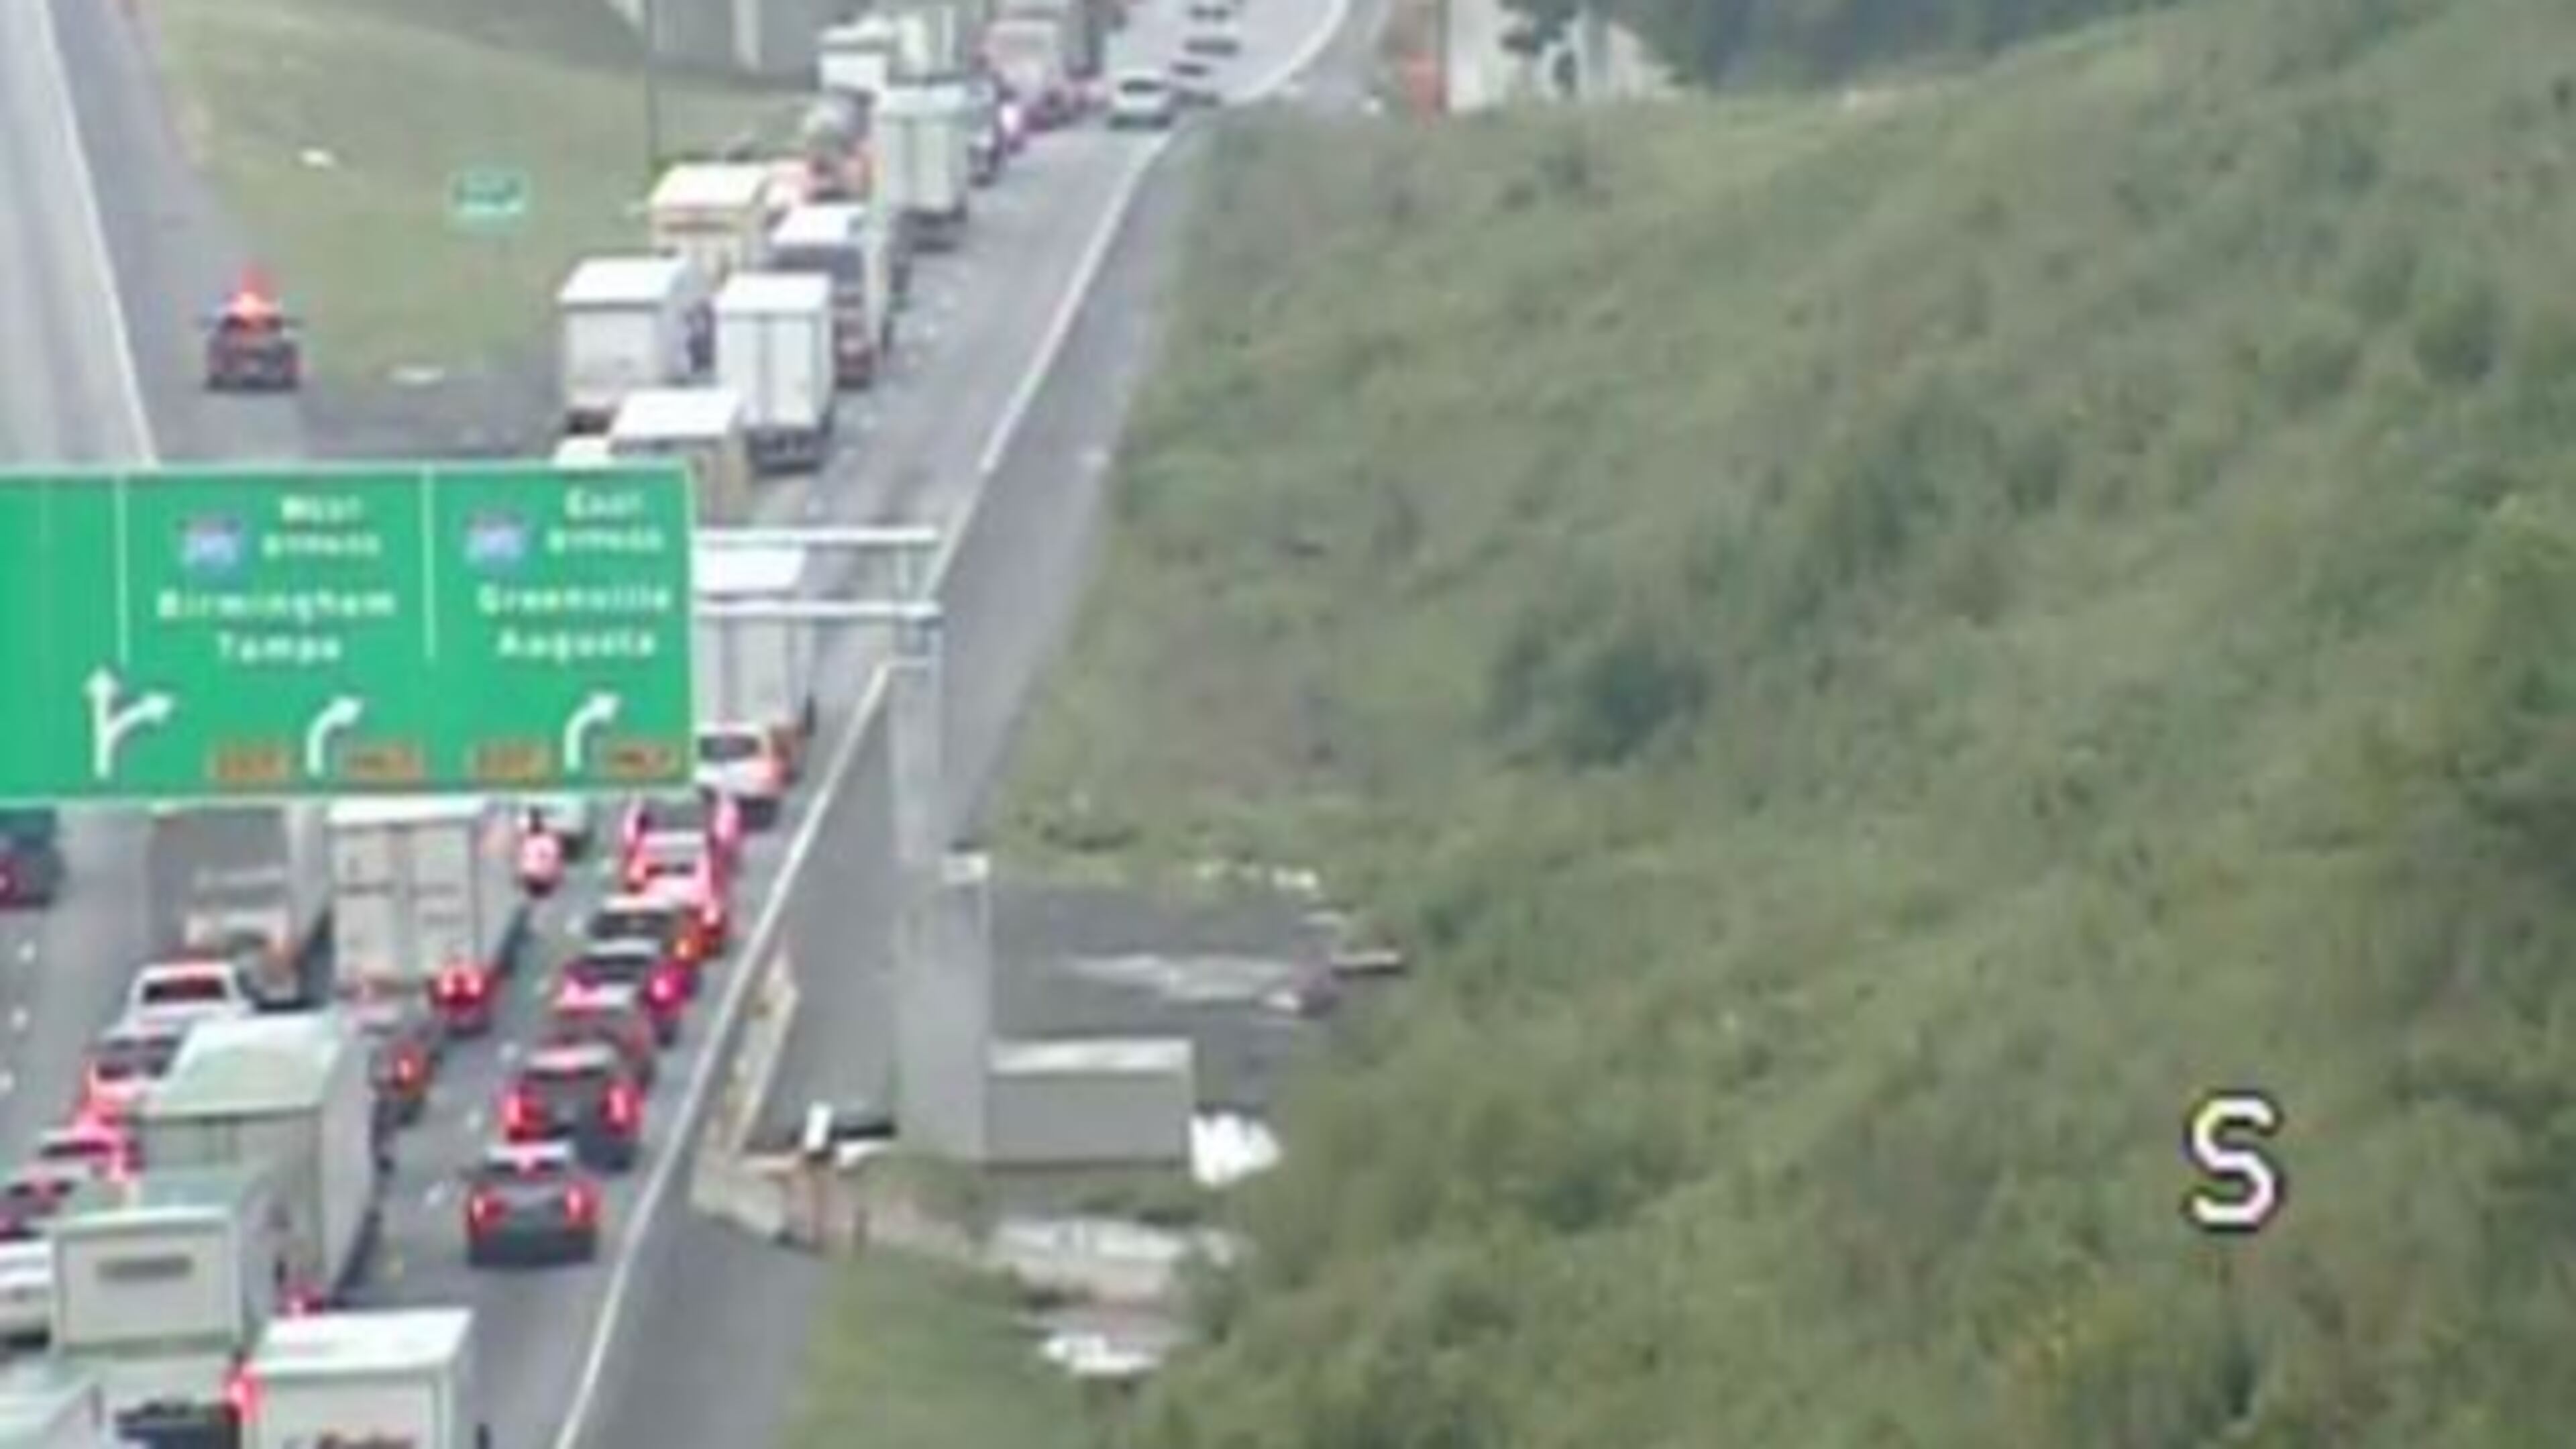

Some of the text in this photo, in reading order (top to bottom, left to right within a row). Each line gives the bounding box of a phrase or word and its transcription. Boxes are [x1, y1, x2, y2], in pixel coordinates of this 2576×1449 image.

[158, 590, 396, 624] Birmingham
[478, 584, 669, 615] Greenville
[217, 632, 342, 664] Tampa
[498, 629, 655, 664] Augusta
